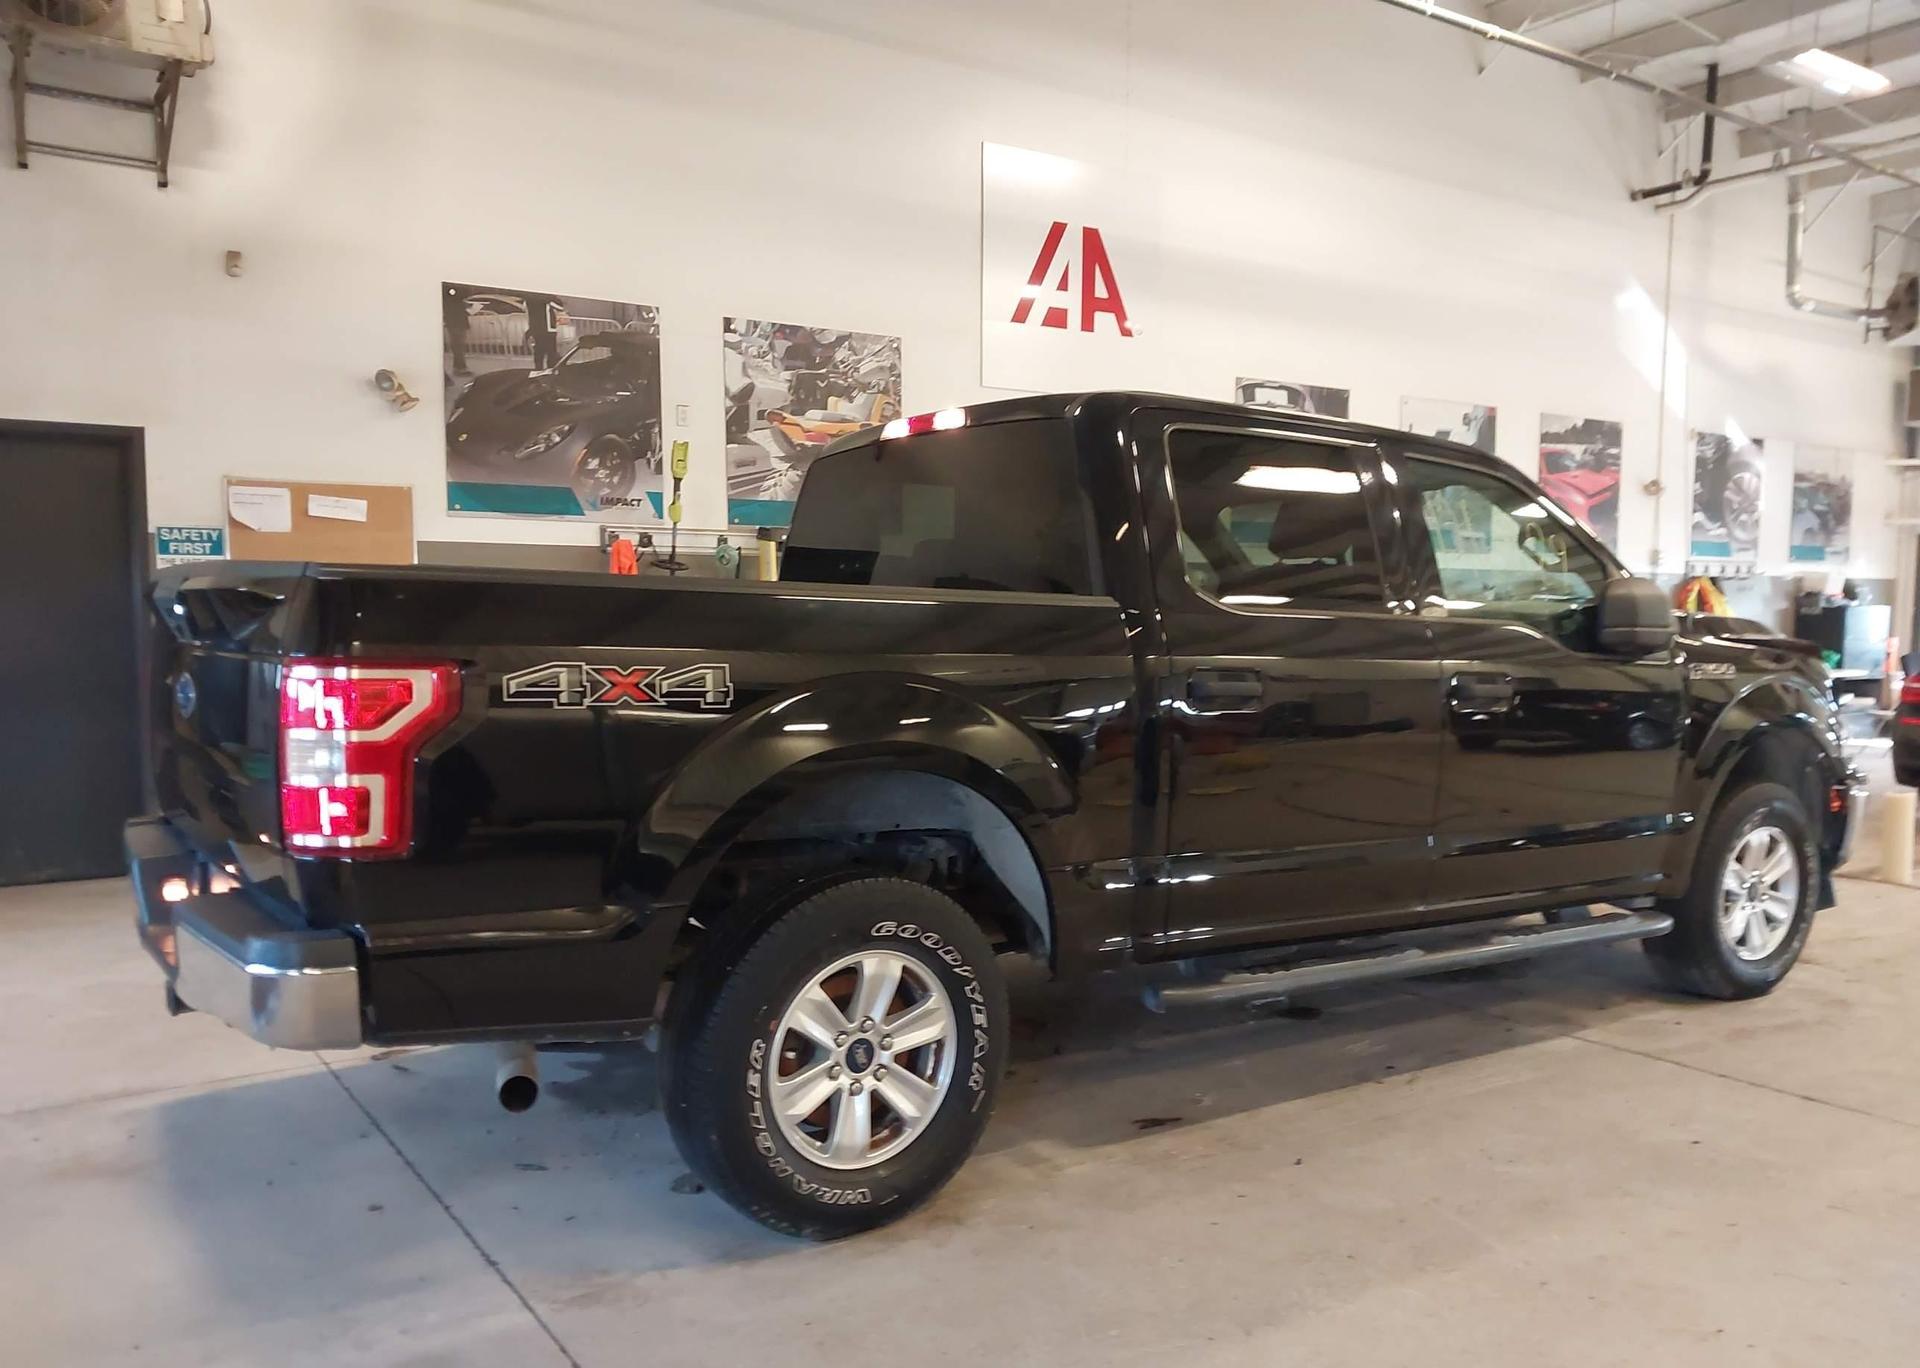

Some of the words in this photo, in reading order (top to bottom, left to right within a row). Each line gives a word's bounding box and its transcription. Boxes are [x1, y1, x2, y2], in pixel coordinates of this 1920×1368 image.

[600, 496, 642, 508] IMPACT
[159, 528, 220, 541] SAFETY
[168, 542, 213, 554] FIRST
[870, 921, 990, 1092] GOODYEAR
[746, 1038, 873, 1205] WRANGLER
